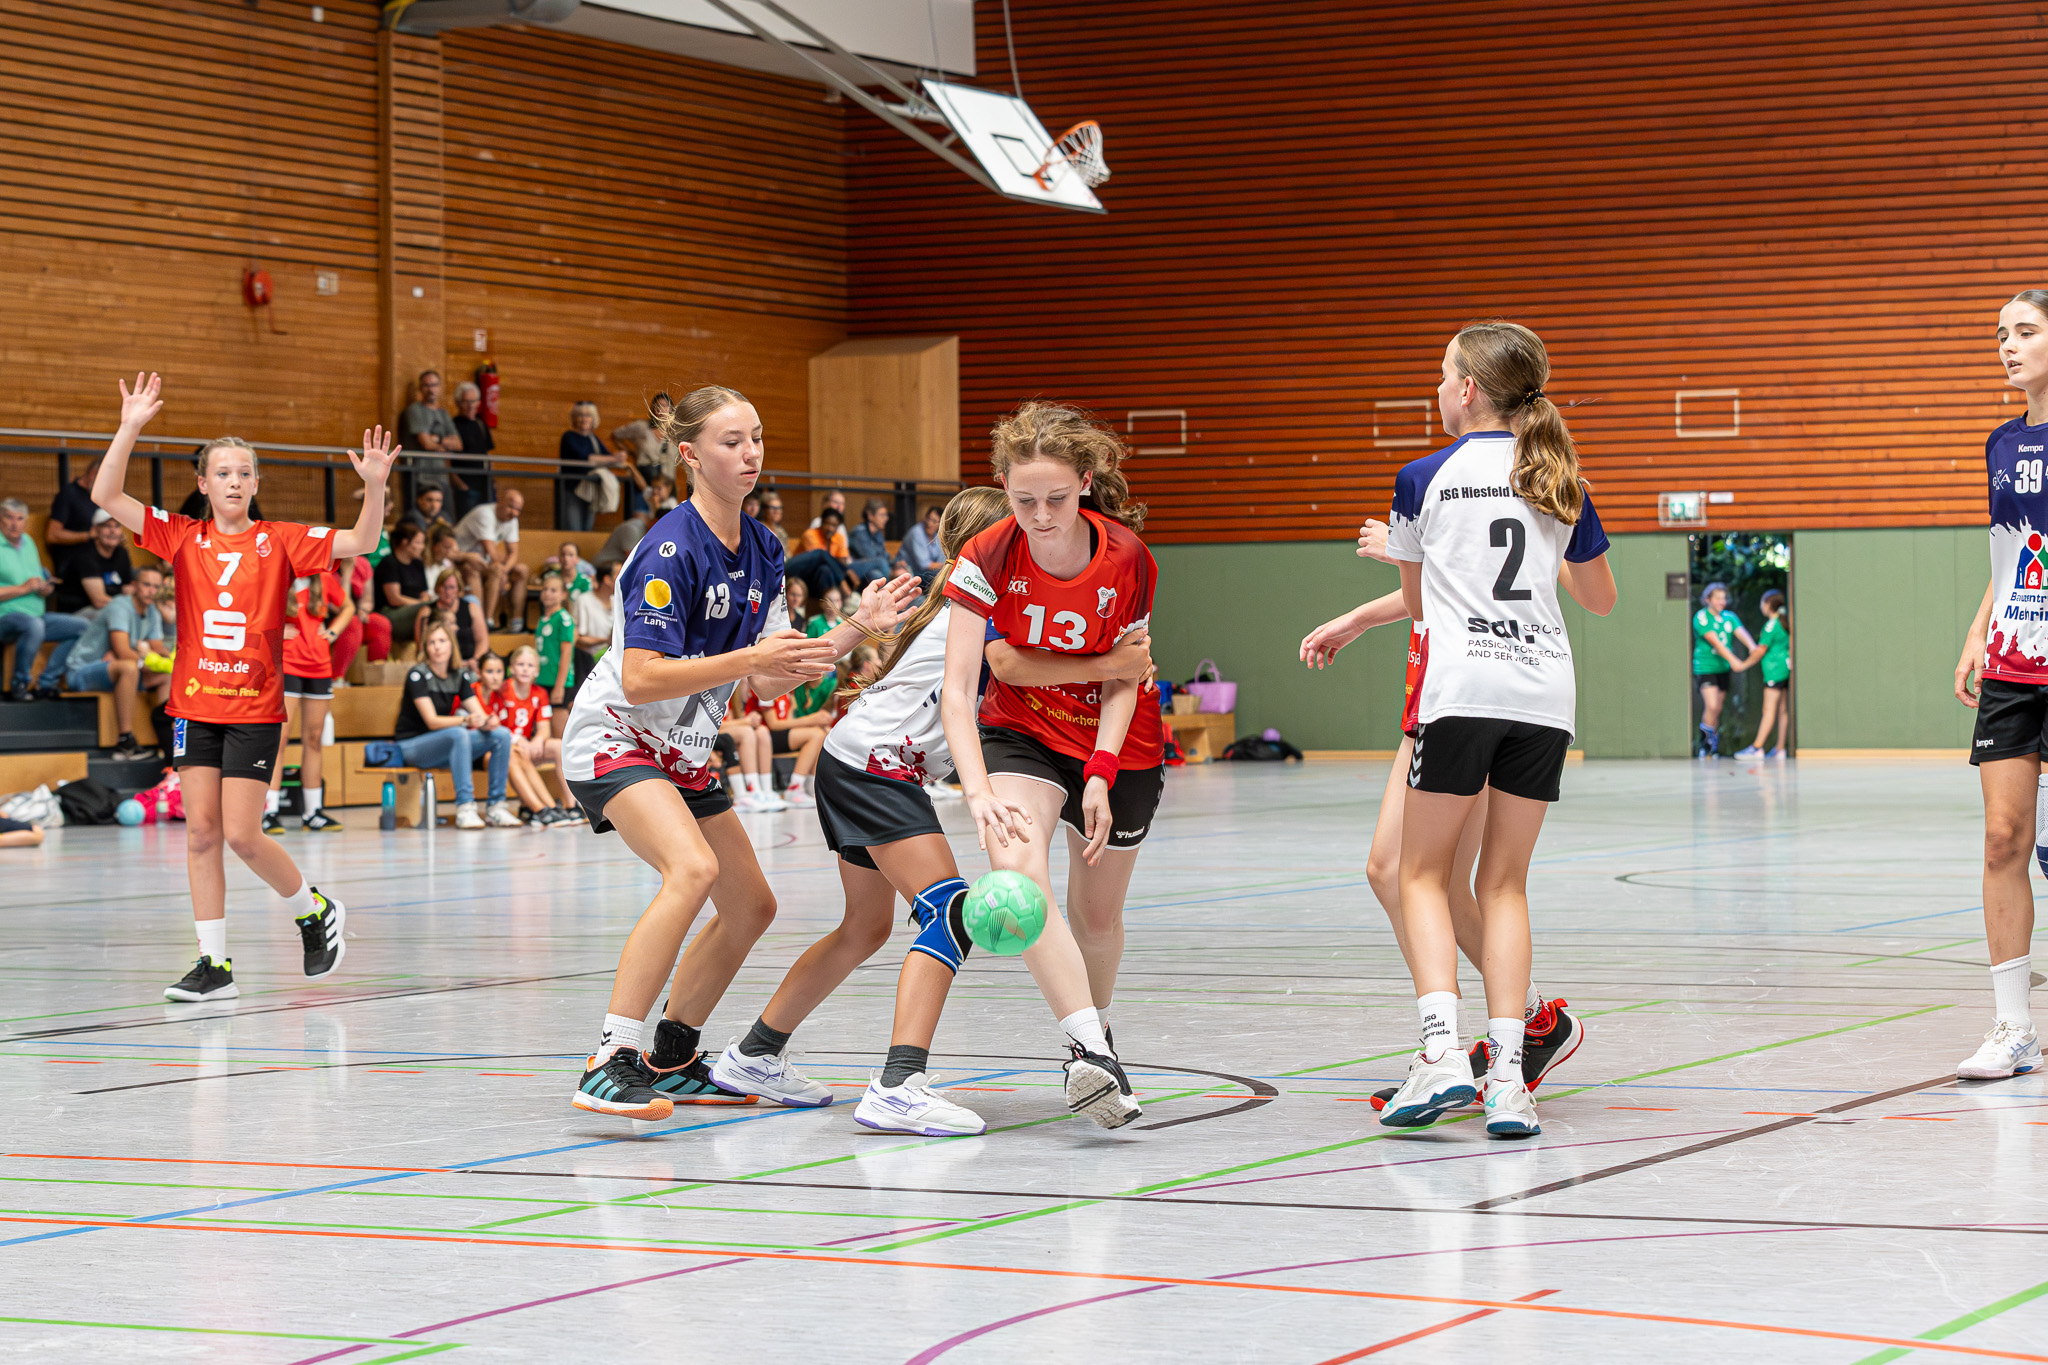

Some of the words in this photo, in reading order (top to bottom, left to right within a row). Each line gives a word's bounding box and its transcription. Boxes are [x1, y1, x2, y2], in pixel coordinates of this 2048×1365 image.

[2018, 444, 2044, 454] Kempa
[2014, 459, 2044, 494] 39
[1439, 488, 1460, 502] JSG
[1461, 486, 1510, 499] Hiesfeld
[1490, 518, 1532, 601] 2
[217, 552, 243, 586] 7
[728, 570, 745, 581] mpa
[963, 576, 997, 602] Grewing
[2010, 591, 2048, 603] Bauzentr
[705, 583, 731, 620] 13
[644, 616, 667, 630] Lang
[1022, 604, 1087, 650] 13
[1468, 640, 1512, 653] PASSION
[198, 657, 250, 674] Nispa.de
[1467, 650, 1492, 658] AND
[1494, 651, 1540, 666] SERVICES
[1046, 706, 1100, 727] Hähnchen
[667, 728, 717, 749] kleinf
[1424, 1014, 1437, 1023] JSG
